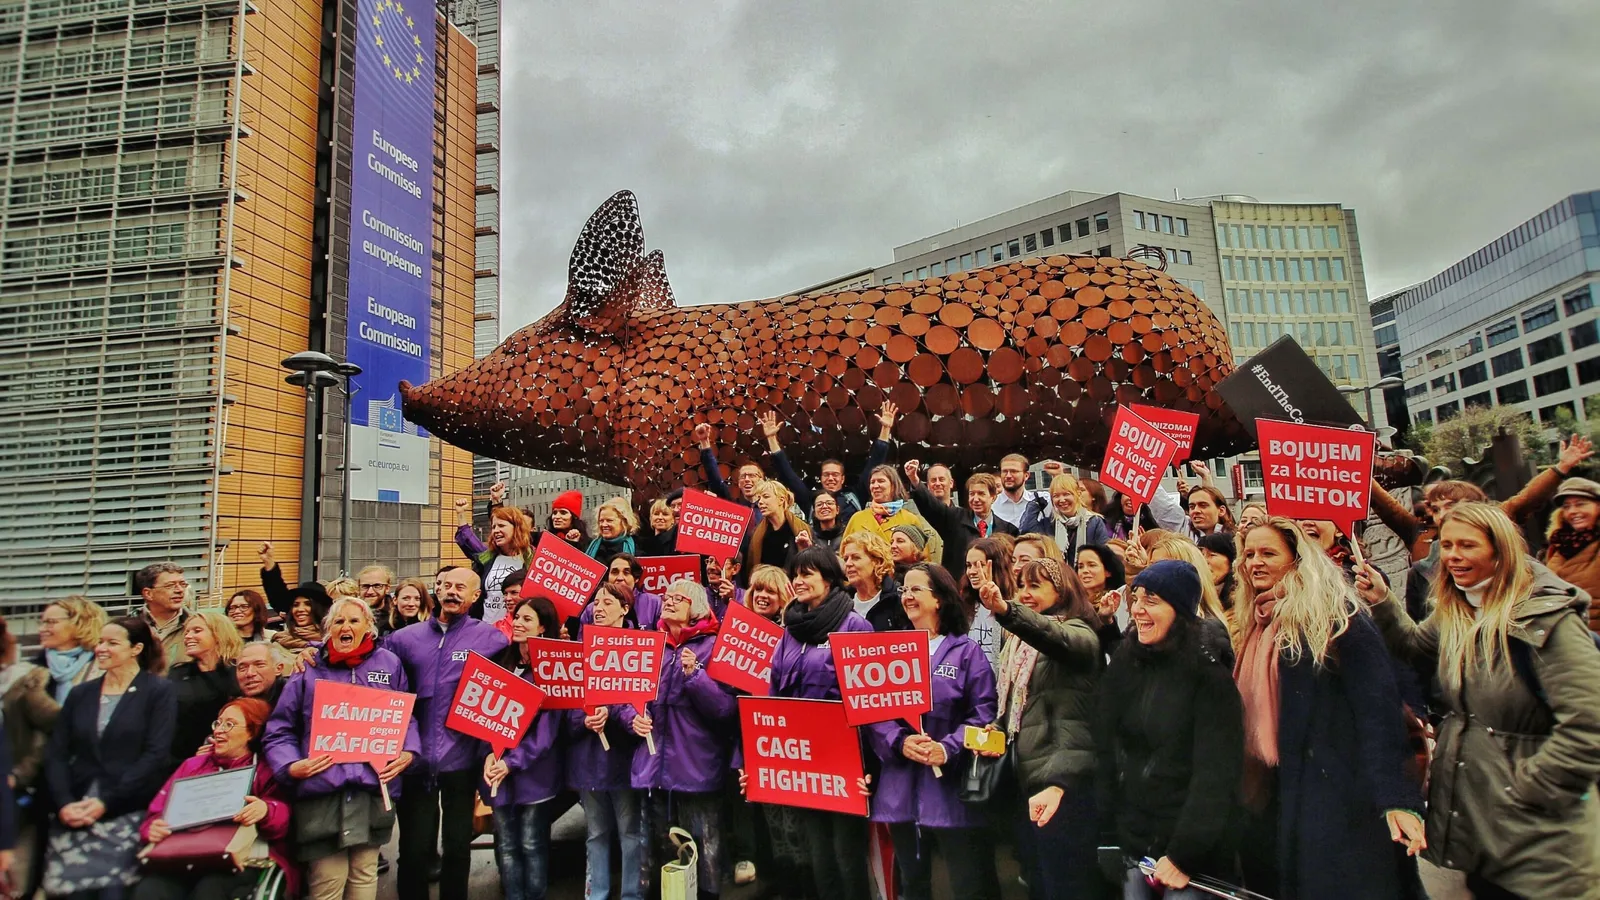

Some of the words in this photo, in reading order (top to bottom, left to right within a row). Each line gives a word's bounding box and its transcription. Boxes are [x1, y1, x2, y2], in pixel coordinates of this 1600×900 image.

[372, 130, 418, 172] Europese
[367, 153, 422, 199] Commissie
[362, 209, 424, 255] Commission
[363, 239, 422, 279] européenne
[367, 296, 416, 330] European
[359, 321, 422, 357] Commission
[1251, 364, 1304, 424] #EndTheCa
[1119, 421, 1166, 458] BOJUJI
[1269, 440, 1361, 463] BOJUJEM
[368, 459, 410, 472] ec.europa.eu
[1113, 442, 1125, 456] za
[1125, 447, 1157, 475] konec
[1270, 464, 1290, 477] za
[1296, 463, 1361, 483] koniec
[1105, 456, 1156, 498] KLECÍ
[1271, 483, 1362, 508] KLIETOK
[683, 511, 742, 535] CONTRO
[685, 502, 702, 511] Sono
[715, 507, 744, 521] attivista
[680, 524, 694, 536] LE
[695, 528, 739, 548] GABBIE
[535, 556, 592, 592] CONTRO
[540, 547, 557, 559] Sono
[557, 554, 597, 579] un'attivista
[528, 570, 541, 584] LE
[542, 577, 586, 606] GABBIE
[590, 634, 607, 647] Je
[609, 634, 633, 646] suis
[637, 636, 655, 646] un
[722, 633, 767, 660] contra
[730, 617, 749, 635] YO
[750, 627, 781, 648] LUC
[537, 649, 548, 659] Je
[550, 650, 571, 658] suis
[713, 646, 772, 684] JAULA
[842, 646, 855, 660] Ik
[859, 643, 886, 658] ben
[890, 641, 917, 654] een
[470, 668, 491, 686] Jeg
[493, 679, 507, 689] er
[534, 660, 584, 681] «CAG
[844, 658, 922, 689] KOOI
[321, 702, 403, 724] KÄMPFE
[460, 680, 525, 729] BUR
[848, 690, 924, 709] VECHTER
[369, 726, 400, 736] gegen
[454, 705, 516, 740] BEKÆMPER
[753, 711, 774, 726] I'm
[778, 715, 786, 727] a
[314, 732, 398, 755] KÄFIGE
[756, 736, 812, 761] CAGE
[758, 767, 849, 798] FIGHTER
